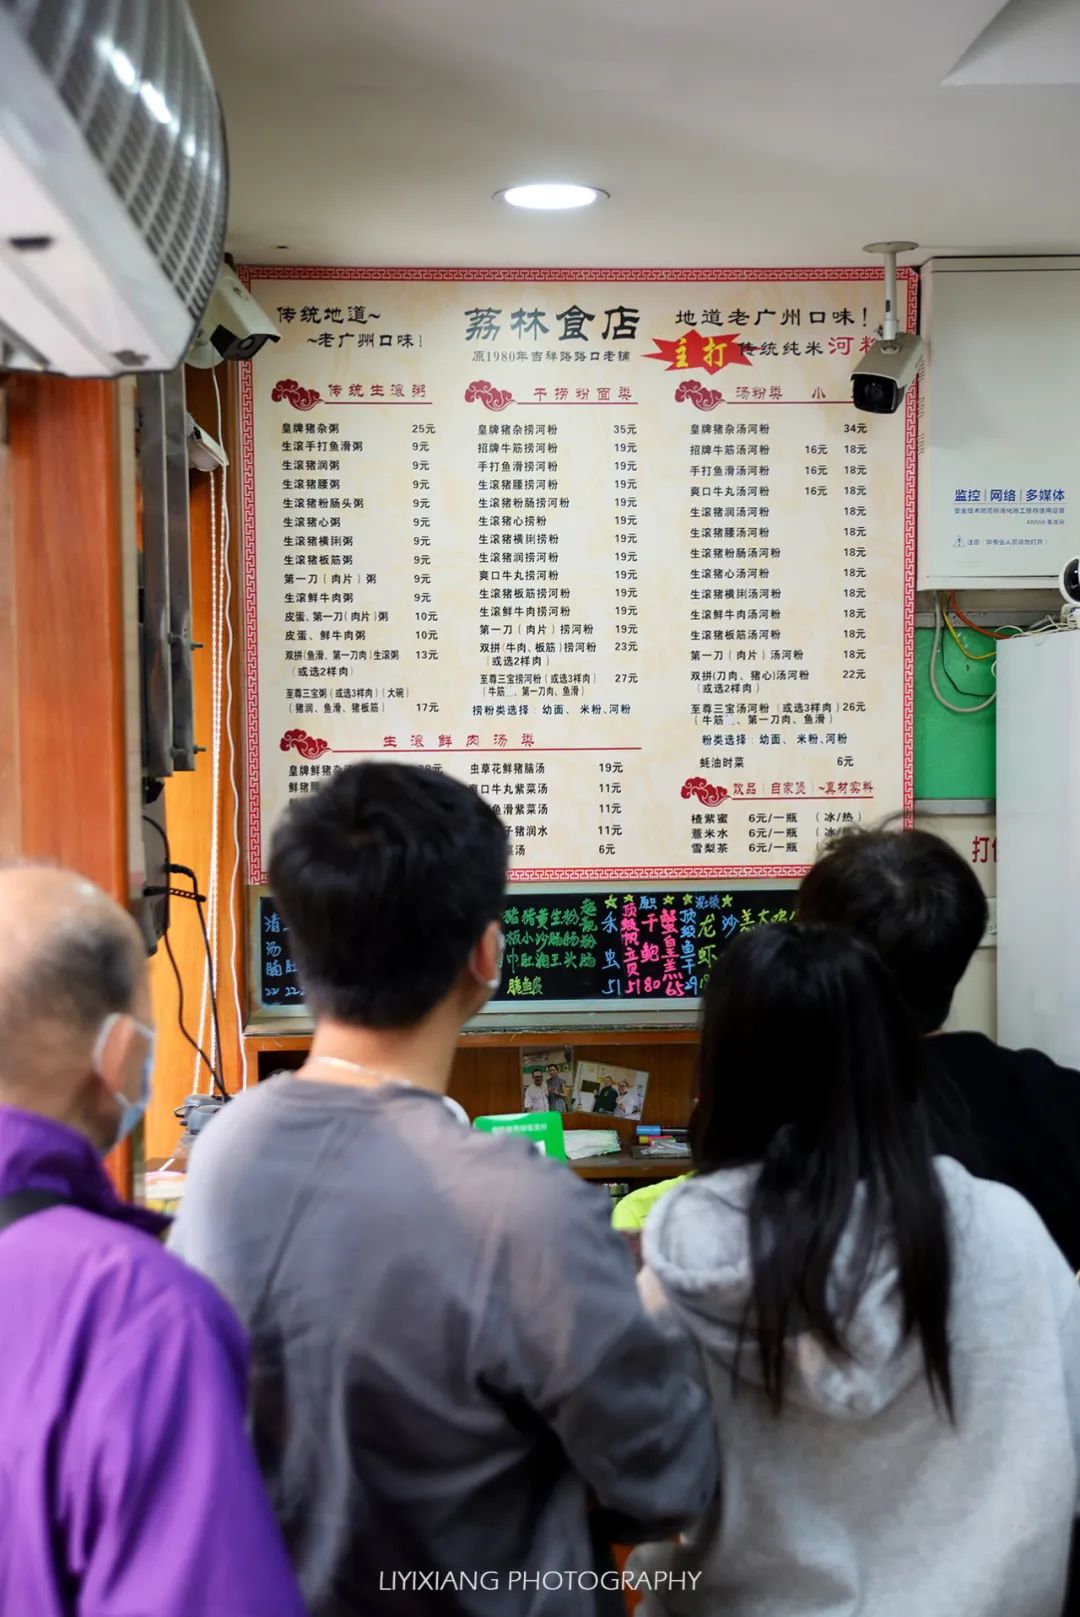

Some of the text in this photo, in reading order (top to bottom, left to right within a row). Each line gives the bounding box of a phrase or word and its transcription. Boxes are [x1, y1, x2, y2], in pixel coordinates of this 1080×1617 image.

[464, 304, 641, 342] 荔林食店
[673, 337, 728, 368] 主打
[533, 386, 633, 401] 干捞粉面类
[735, 385, 784, 400] 汤粉类
[281, 423, 436, 434] 皇牌猪杂粥 25元
[477, 424, 637, 435] 皇牌猪杂捞河粉 35元
[690, 424, 868, 435] 皇牌猪杂汤河粉 34元
[281, 441, 430, 452] 生滚手打鱼滑粥 9元
[477, 443, 638, 454] 招牌牛筋捞河粉 19元
[690, 444, 868, 456] 招牌牛筋汤河粉 16元 18元
[282, 460, 430, 471] 生滚猪润粥 9元
[477, 461, 638, 472] 手打鱼滑捞河粉 19元
[690, 465, 868, 477] 手打鱼滑汤河粉 16元 18元
[282, 479, 430, 490] 生滚猪腰粥 9元
[477, 479, 638, 491] 生滚猪腰捞河粉 19元
[690, 486, 867, 497] 爽口牛丸汤河粉 16元 18元
[954, 489, 1065, 502] 监控 网络 多媒体
[282, 498, 430, 509] 生滚猪粉肠头粥 9元
[478, 497, 638, 509] 生滚猪粉肠捞河粉 19元
[690, 507, 867, 518] 生滚猪润汤河粉 18元
[283, 517, 431, 528] 生滚猪心粥 9元
[478, 515, 638, 527] 生滚猪心捞粉 19元
[690, 527, 867, 538] 生滚猪腰汤河粉 18元
[413, 536, 431, 546] 9元
[614, 534, 638, 544] 19元
[478, 552, 638, 563] 生滚猪润捞河粉 19元
[690, 547, 867, 559] 生滚猪粉肠汤河粉 18元
[284, 555, 431, 566] 生滚猪板筋粥 9元
[414, 574, 431, 584] 9元
[479, 570, 638, 582] 爽口牛丸捞河粉 19元
[690, 568, 866, 580] 生滚猪心汤河粉 18元
[284, 592, 432, 604] 生滚鲜牛肉粥 9元
[479, 588, 638, 599] 生滚猪板筋捞河粉 19元
[843, 588, 866, 599] 18元
[415, 612, 438, 622] 10元
[479, 606, 638, 617] 生滚鲜牛肉捞河粉 19元
[690, 609, 866, 620] 生滚鲜牛肉汤河粉 18元
[615, 624, 638, 634] 19元
[285, 630, 439, 641] 皮蛋、鲜牛肉粥 10元
[690, 629, 866, 641] 生滚猪板筋汤河粉 18元
[614, 641, 638, 652] 23元
[415, 650, 439, 660] 13元
[842, 650, 866, 660] 18元
[614, 673, 638, 684] 27元
[842, 670, 866, 680] 22元
[416, 703, 439, 713] 17元
[842, 702, 866, 712] 26元
[383, 733, 535, 748] 生滚鲜肉汤类
[470, 762, 624, 774] 虫草花鲜猪脑汤 19元
[699, 756, 854, 769] 蚝油时菜 6元
[599, 783, 622, 794] 11元
[599, 803, 622, 814] 11元
[748, 812, 798, 824] 6元/一瓶
[598, 824, 623, 836] 11元
[691, 827, 798, 839] 薏米水 6元/一瓶
[598, 844, 616, 855] 6元
[691, 842, 798, 854] 雪梨茶 6元/一瓶
[971, 835, 997, 864] 打
[644, 976, 661, 993] 80
